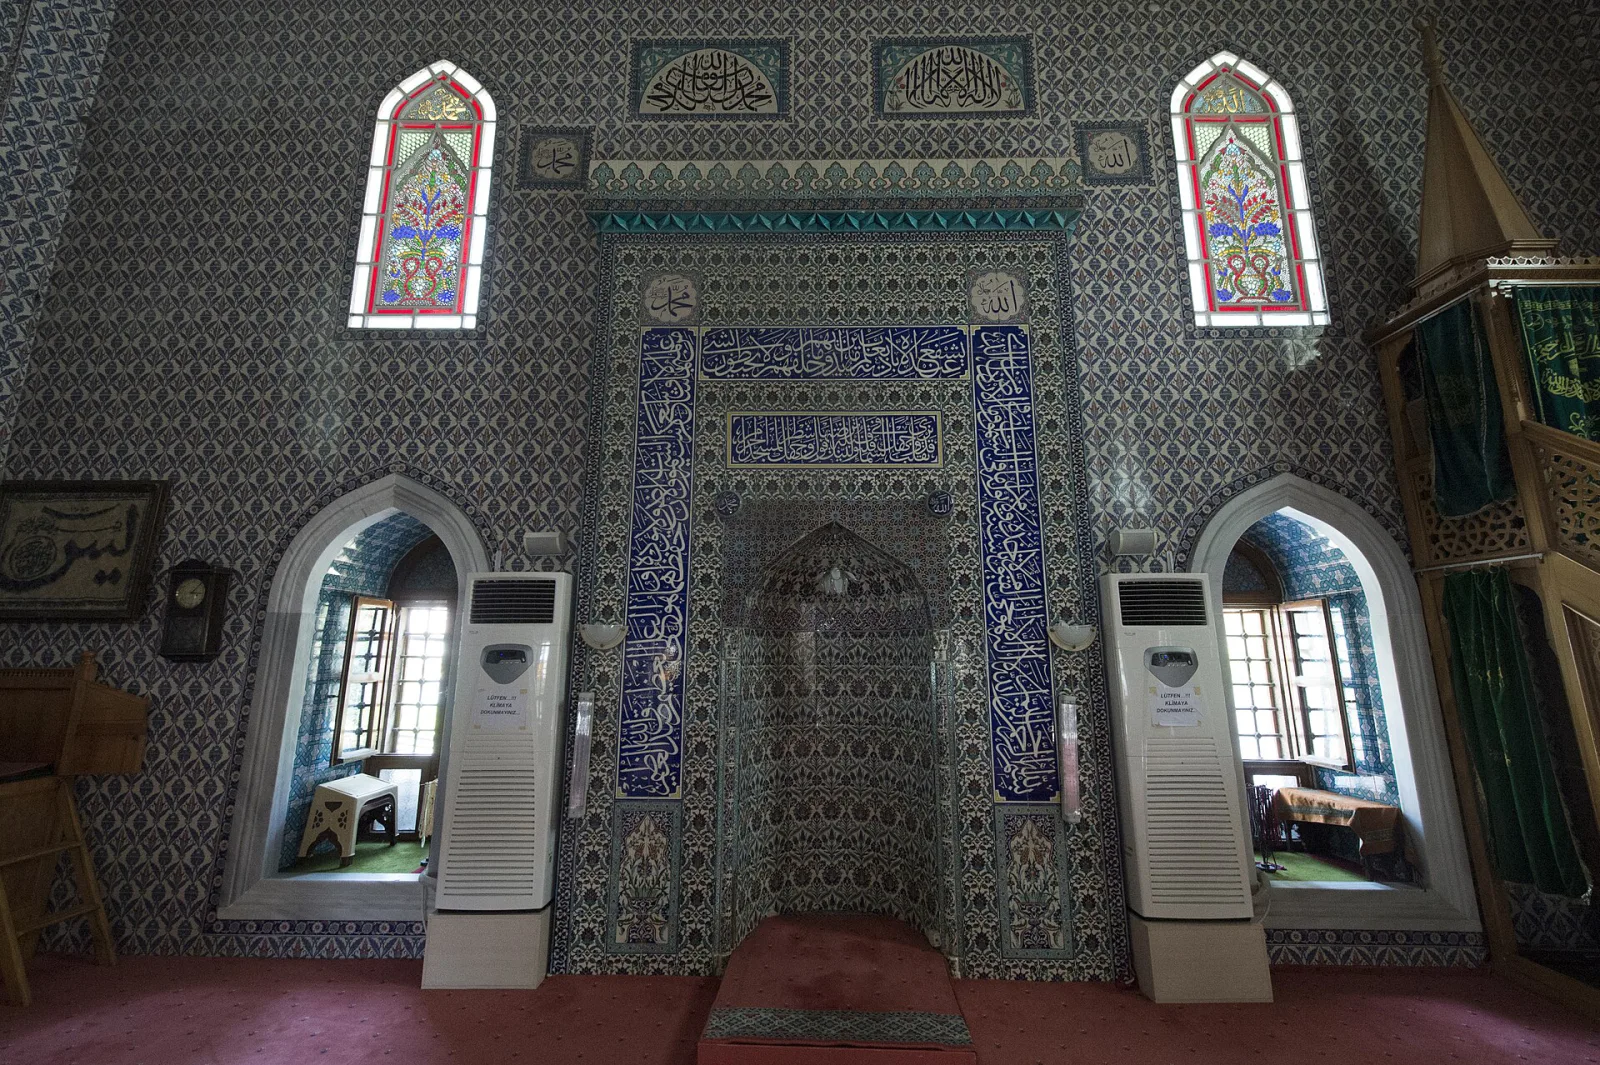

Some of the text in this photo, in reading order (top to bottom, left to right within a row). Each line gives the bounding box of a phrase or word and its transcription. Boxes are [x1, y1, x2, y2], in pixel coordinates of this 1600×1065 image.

[536, 147, 576, 175] محمد
[1100, 138, 1132, 169] الله
[650, 286, 694, 318] محمد
[982, 279, 1018, 315] الله
